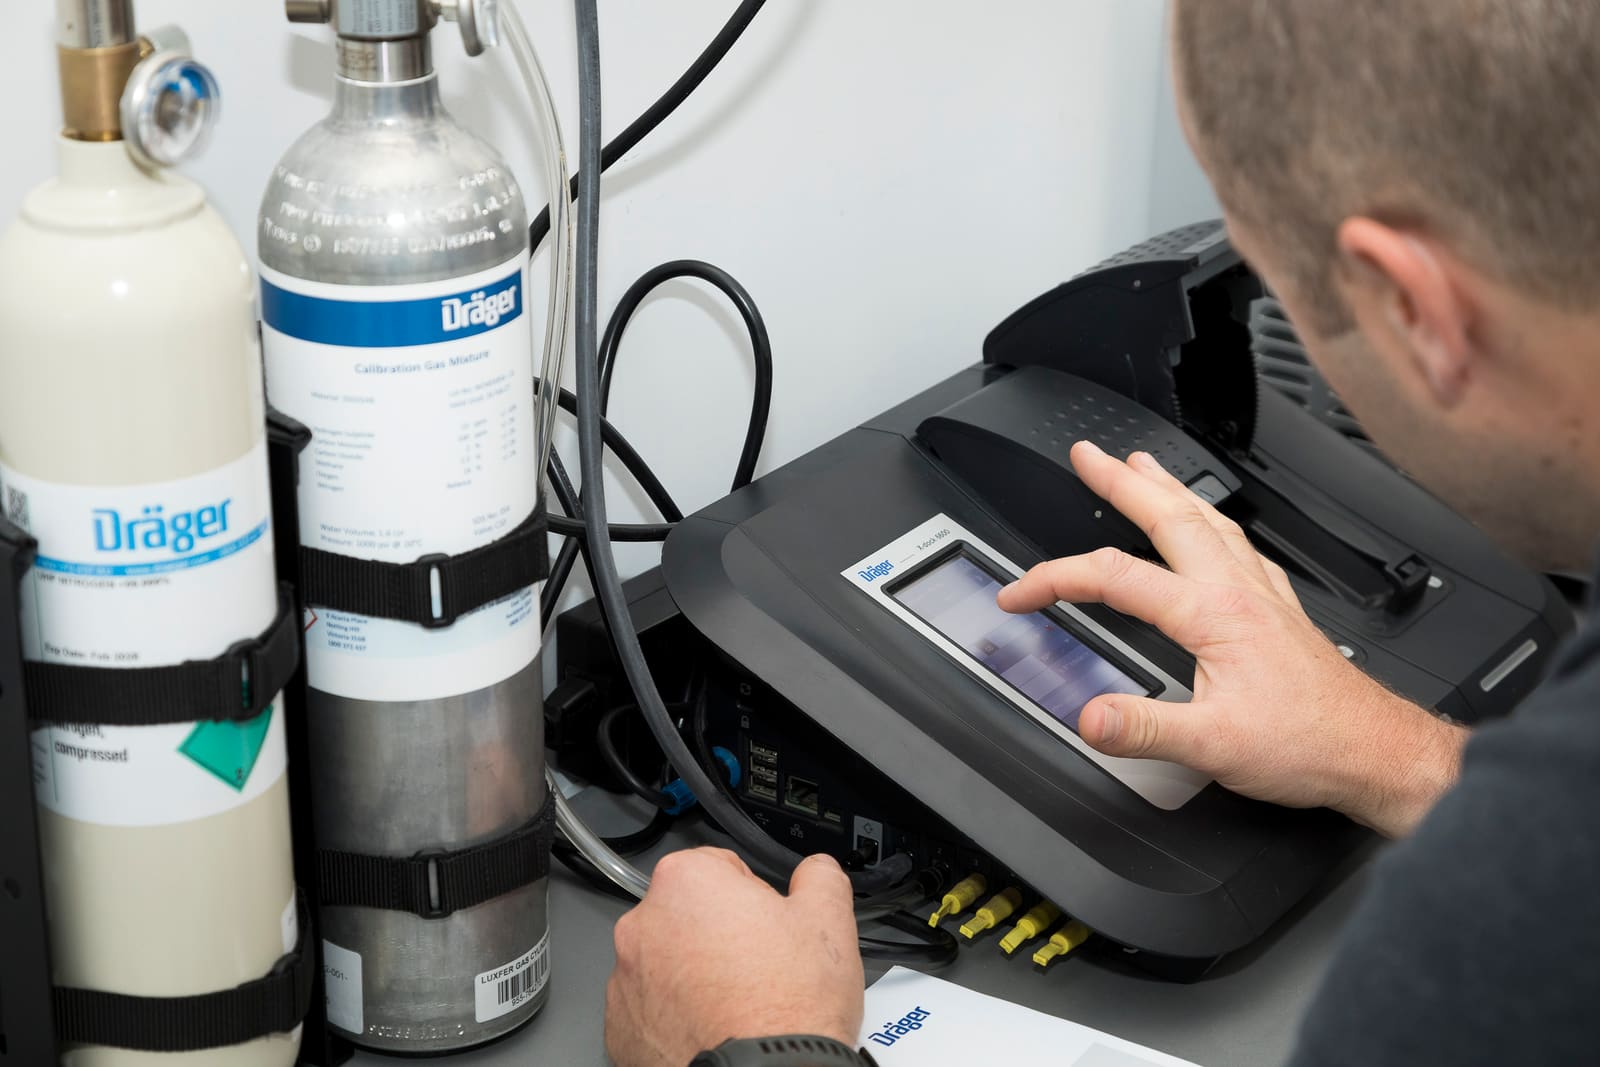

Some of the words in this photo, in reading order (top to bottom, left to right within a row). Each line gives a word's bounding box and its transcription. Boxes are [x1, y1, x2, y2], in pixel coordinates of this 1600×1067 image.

[441, 285, 516, 332] Dräger
[354, 361, 421, 375] Calibration
[424, 358, 446, 370] Gas
[449, 349, 490, 367] Mixture
[92, 498, 231, 553] Dräger
[858, 559, 895, 583] Dräger
[55, 741, 128, 763] compressed
[480, 965, 514, 985] LUXFER
[515, 955, 530, 971] GAS
[868, 1005, 932, 1047] Dräger
